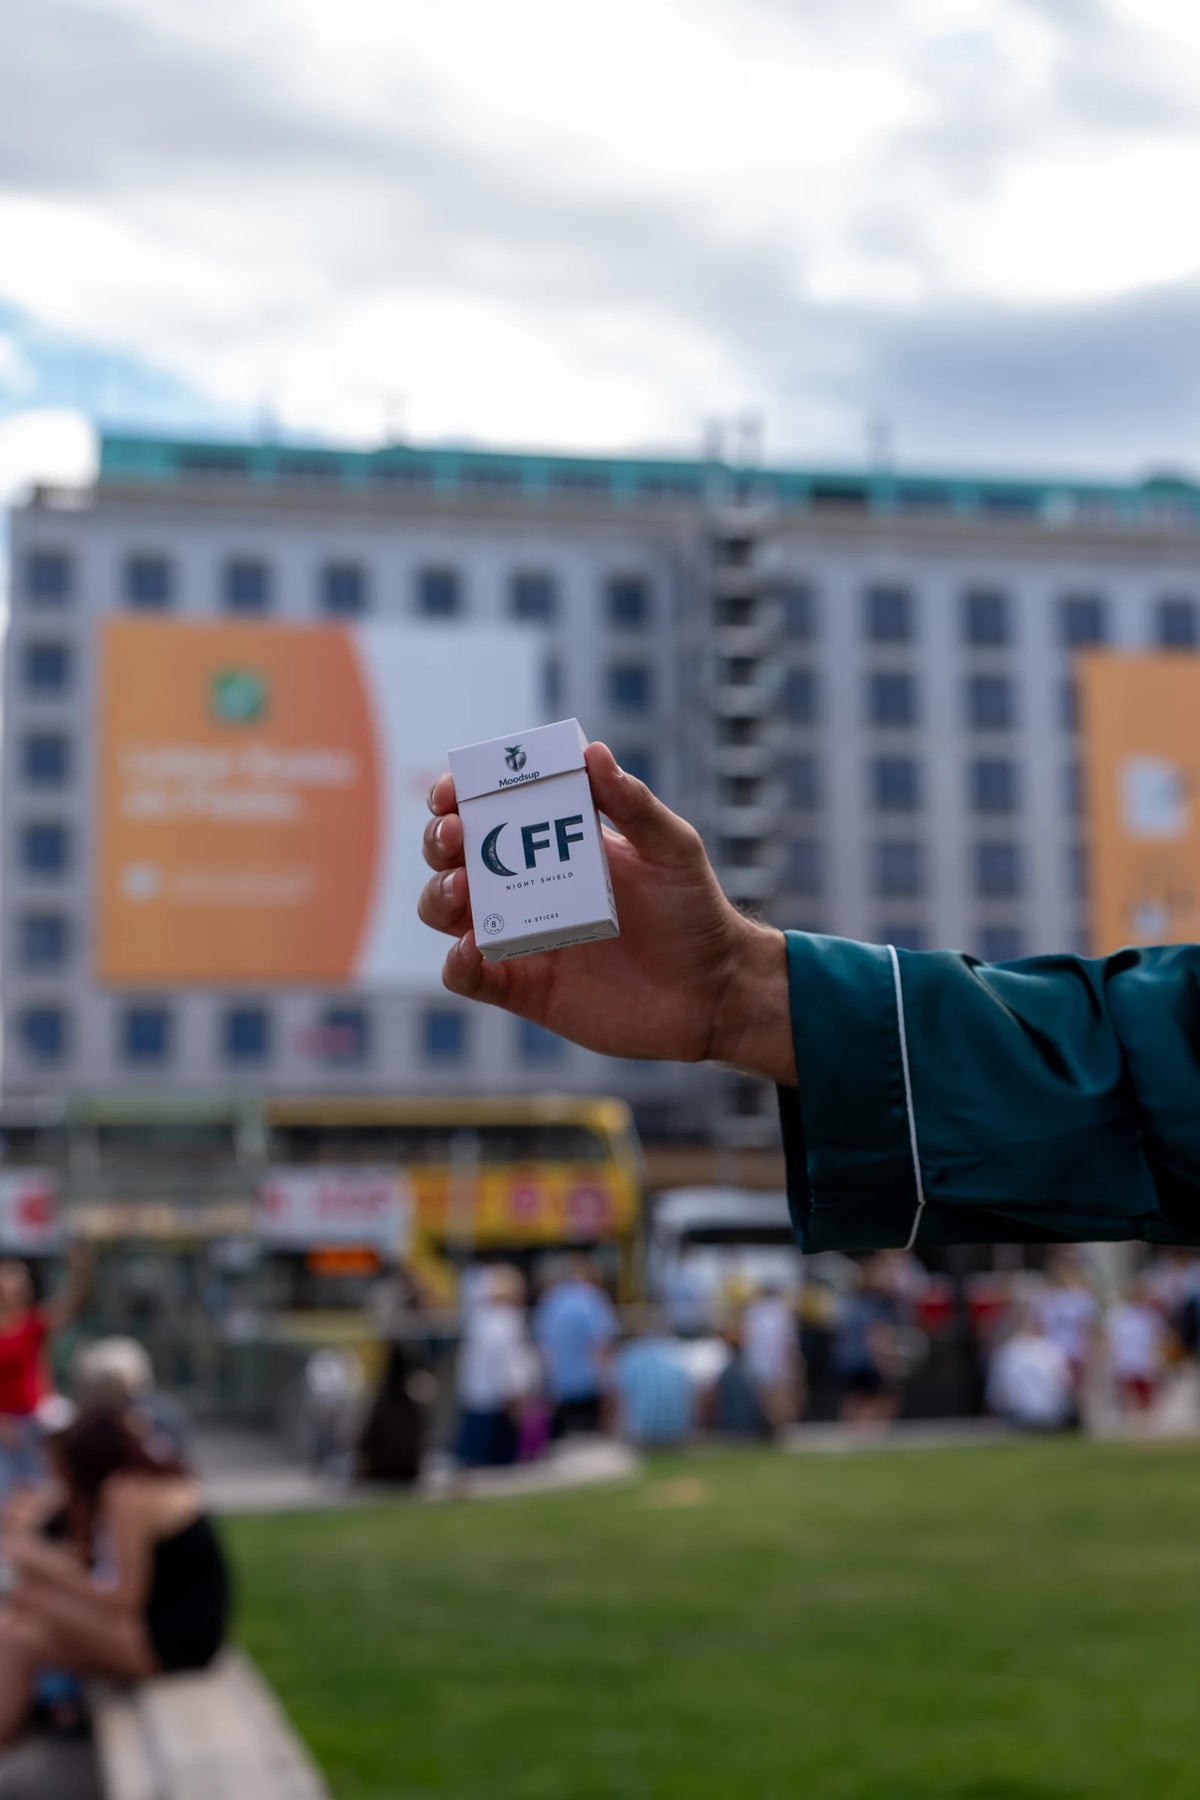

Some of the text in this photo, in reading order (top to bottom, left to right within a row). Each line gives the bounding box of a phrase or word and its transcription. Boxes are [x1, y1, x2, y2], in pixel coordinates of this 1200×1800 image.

[499, 771, 540, 787] Moodsup
[505, 872, 574, 891] NIGHT SHIELD
[534, 912, 560, 922] STICKS
